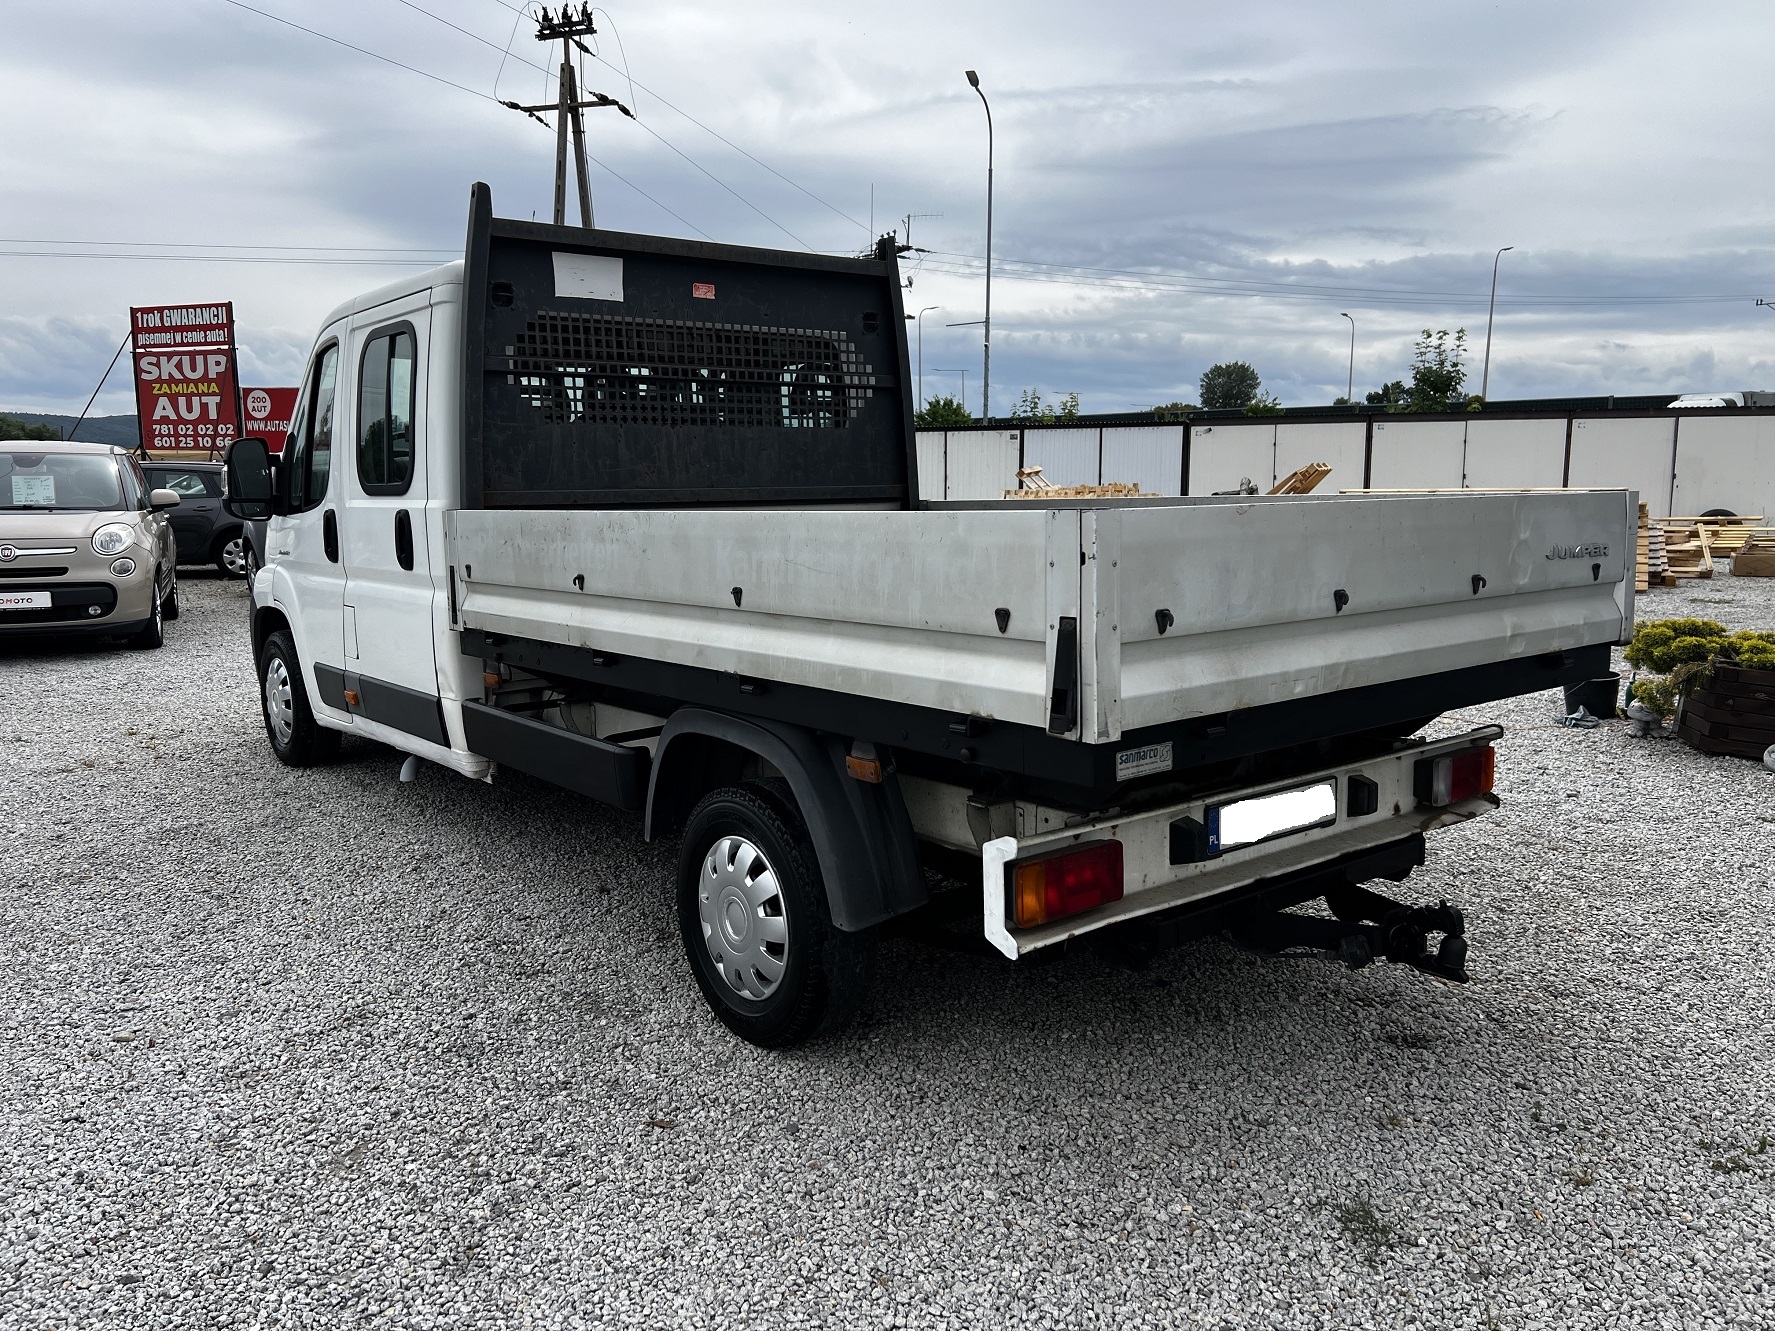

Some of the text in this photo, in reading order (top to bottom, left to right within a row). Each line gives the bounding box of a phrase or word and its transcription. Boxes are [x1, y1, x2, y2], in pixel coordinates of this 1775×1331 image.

[163, 306, 227, 326] GWARANCJI
[137, 327, 228, 346] pisemnej w cenie auta!
[139, 354, 227, 380] SKUP
[152, 382, 219, 395] ZAMIANA
[152, 395, 221, 420] AUT
[251, 396, 267, 404] 200
[251, 405, 267, 413] AUT
[152, 424, 235, 435] 781 02 02 02
[154, 437, 175, 447] 601
[177, 437, 194, 447] 25
[197, 437, 212, 447] 10
[1545, 542, 1610, 560] JUMPER
[1119, 747, 1159, 765] sanmarco
[1209, 835, 1219, 846] PL
